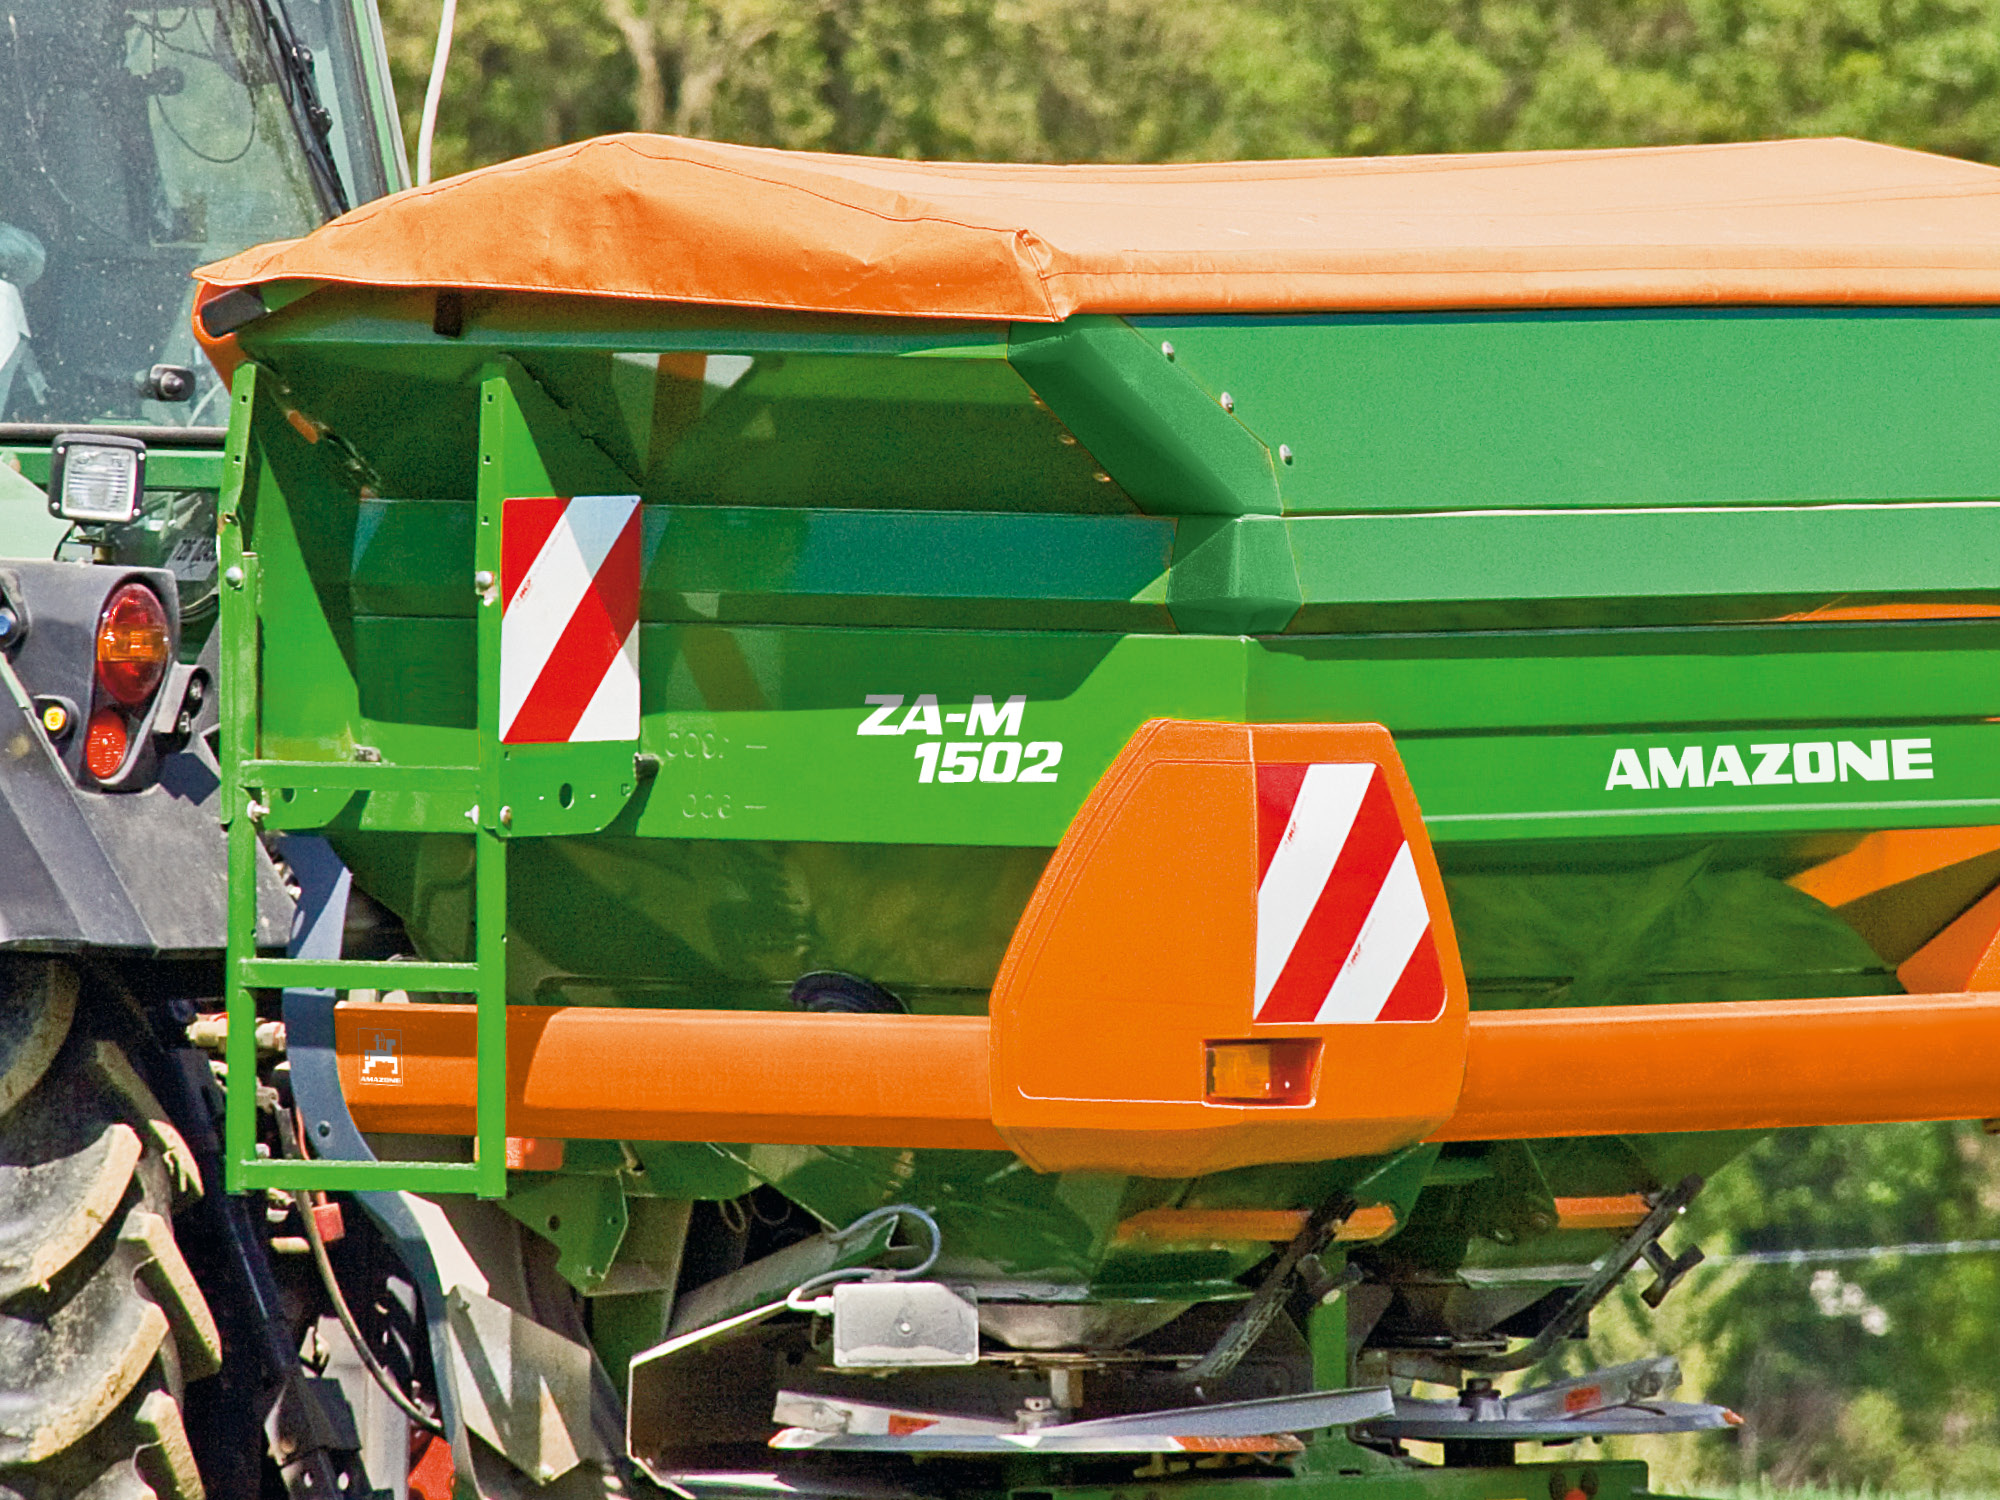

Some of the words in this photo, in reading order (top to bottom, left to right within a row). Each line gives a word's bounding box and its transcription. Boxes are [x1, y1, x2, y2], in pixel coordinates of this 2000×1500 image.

[857, 694, 1027, 736] ZA-M
[914, 741, 1063, 783] 1502
[1604, 738, 1934, 790] AMAZONE
[360, 1076, 402, 1084] AMAZONE
